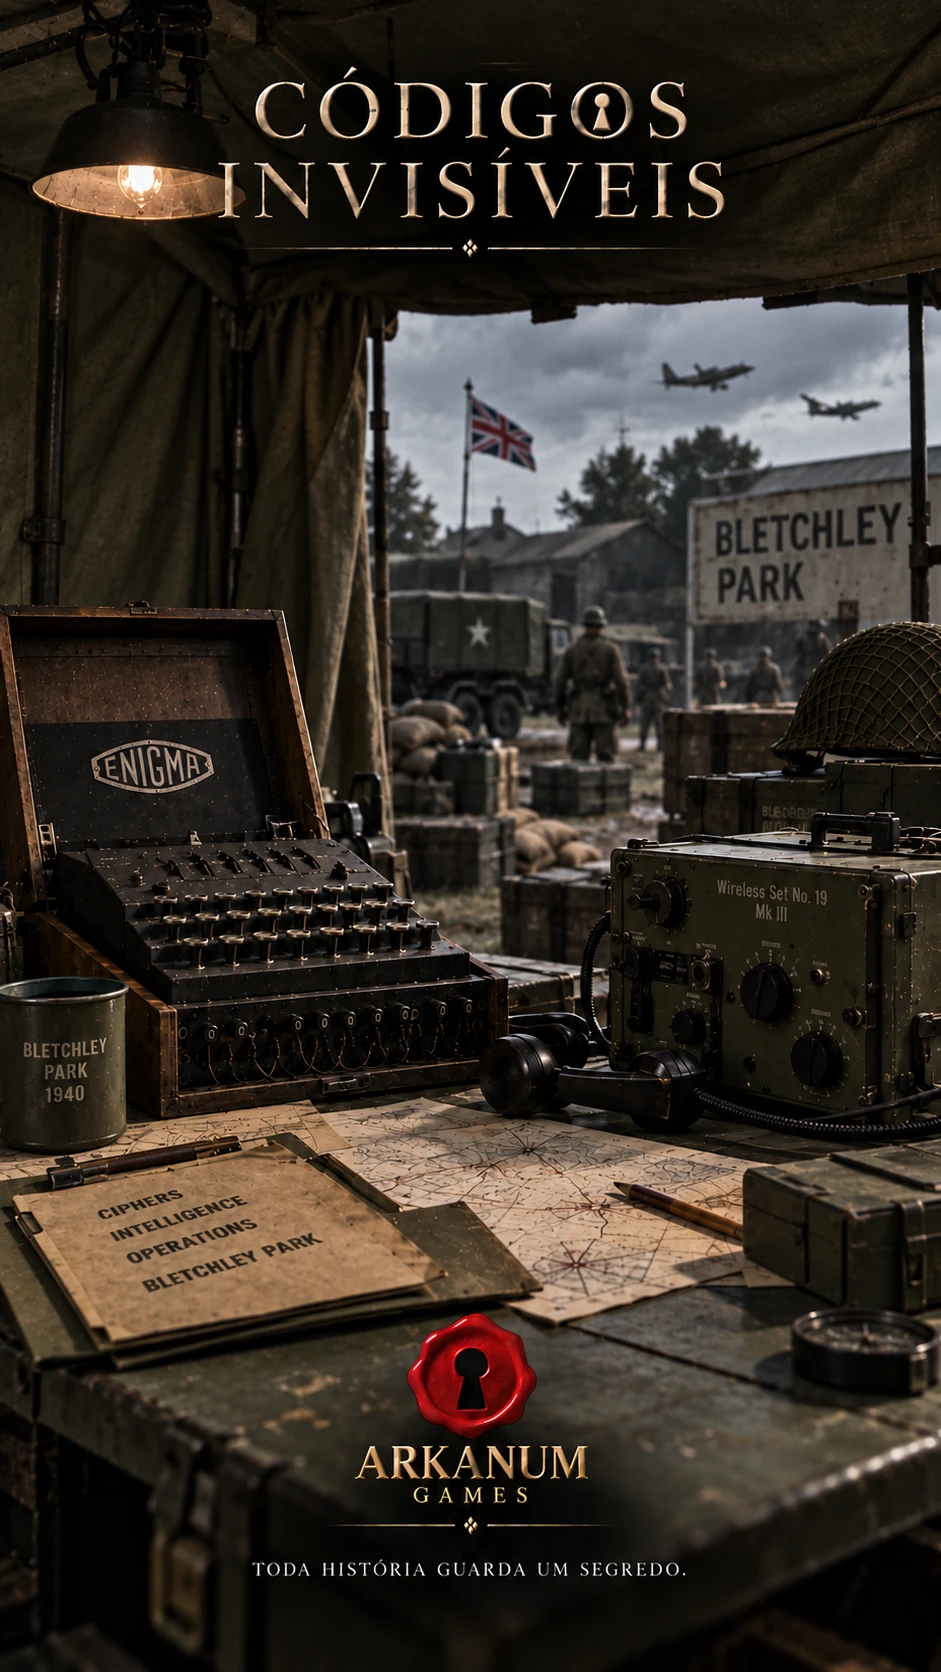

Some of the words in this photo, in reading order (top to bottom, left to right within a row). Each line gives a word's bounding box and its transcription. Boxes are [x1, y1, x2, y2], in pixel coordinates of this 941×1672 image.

[716, 503, 901, 557] BLETCHLEY
[718, 561, 804, 604] PARK
[104, 745, 200, 787] ENIGMA
[717, 879, 766, 900] Wireless
[769, 885, 789, 901] Set
[792, 886, 811, 904] No.
[814, 889, 828, 906] 19
[755, 903, 773, 920] Mk
[776, 906, 788, 922] III
[23, 1037, 107, 1059] BLETCHLEY
[44, 1061, 88, 1080] PARK
[45, 1084, 85, 1103] 1940
[97, 1189, 183, 1220] CIPHERS
[109, 1194, 248, 1242] INTELLIGENCE
[126, 1218, 258, 1264] OPERATIONS
[141, 1250, 258, 1293] BLETCHLEY
[260, 1232, 324, 1258] PARK
